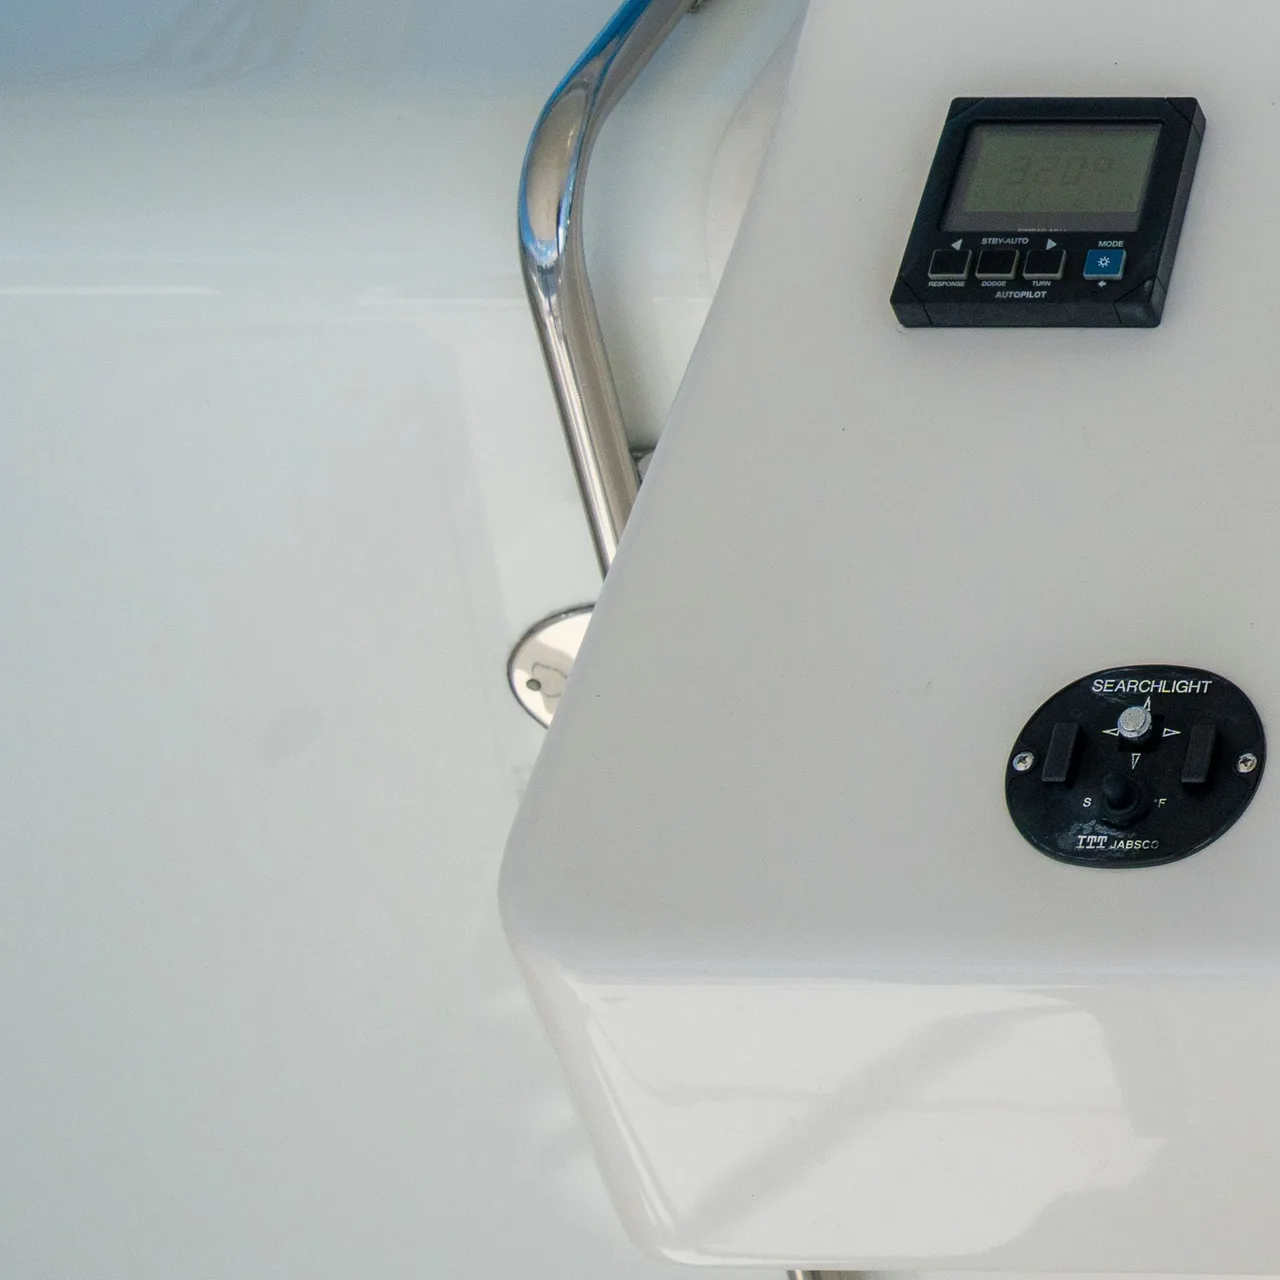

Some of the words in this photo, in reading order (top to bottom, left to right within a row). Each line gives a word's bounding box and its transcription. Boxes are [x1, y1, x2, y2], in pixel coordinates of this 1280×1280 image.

[981, 237, 1030, 245] STBY-AUTO
[995, 291, 1048, 299] AUTOPILOT
[1092, 679, 1213, 694] SEARCHLIGHT
[1083, 798, 1092, 807] S
[1158, 798, 1167, 808] F
[1076, 835, 1108, 849] ITT
[1110, 839, 1159, 850] JABSCO
